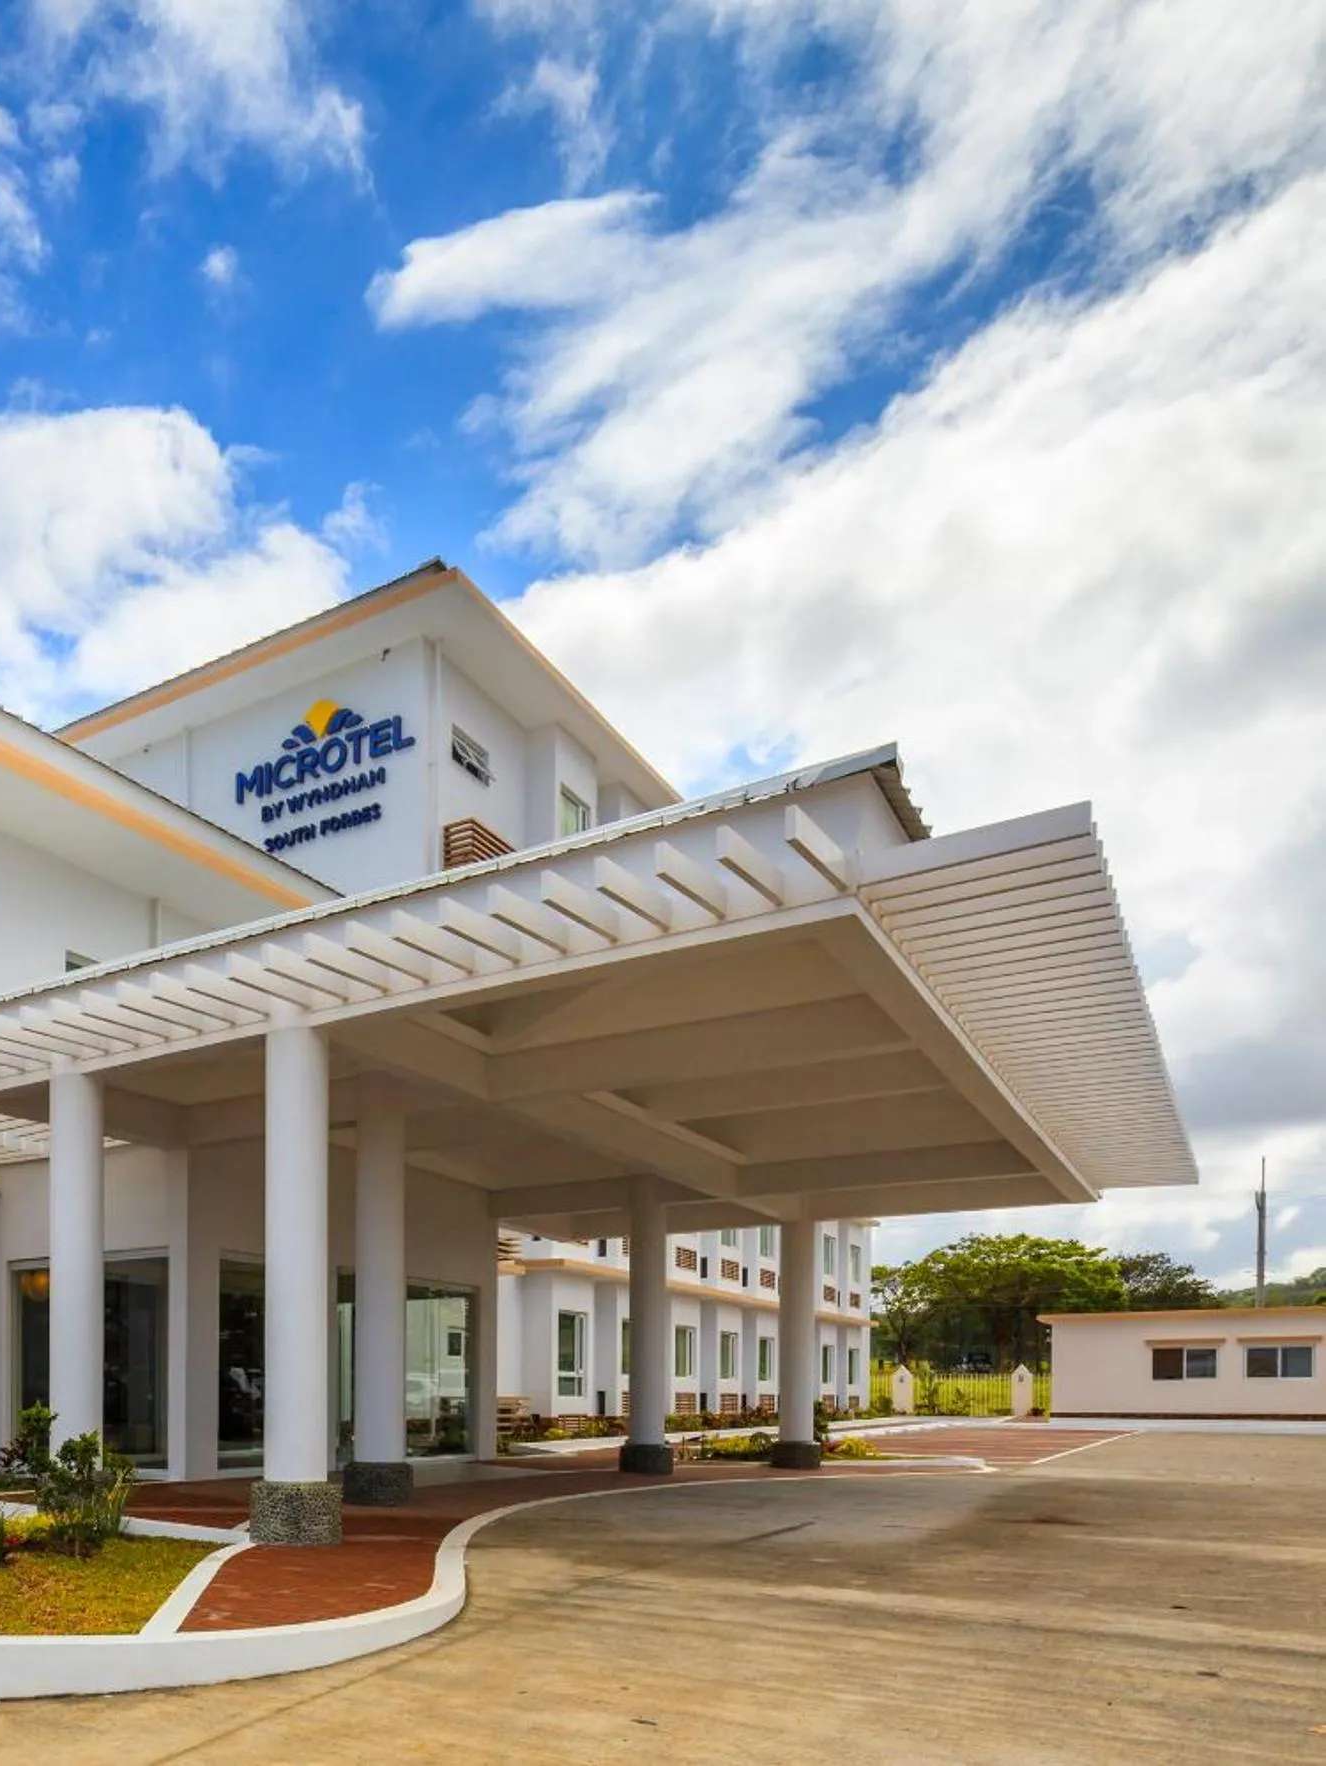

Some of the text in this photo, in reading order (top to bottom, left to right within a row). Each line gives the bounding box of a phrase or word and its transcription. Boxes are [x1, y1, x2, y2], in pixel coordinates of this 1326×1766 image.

[235, 715, 416, 804] MICROTEL
[261, 766, 386, 823] BY WYNDHAM
[263, 823, 317, 853] SOUTH
